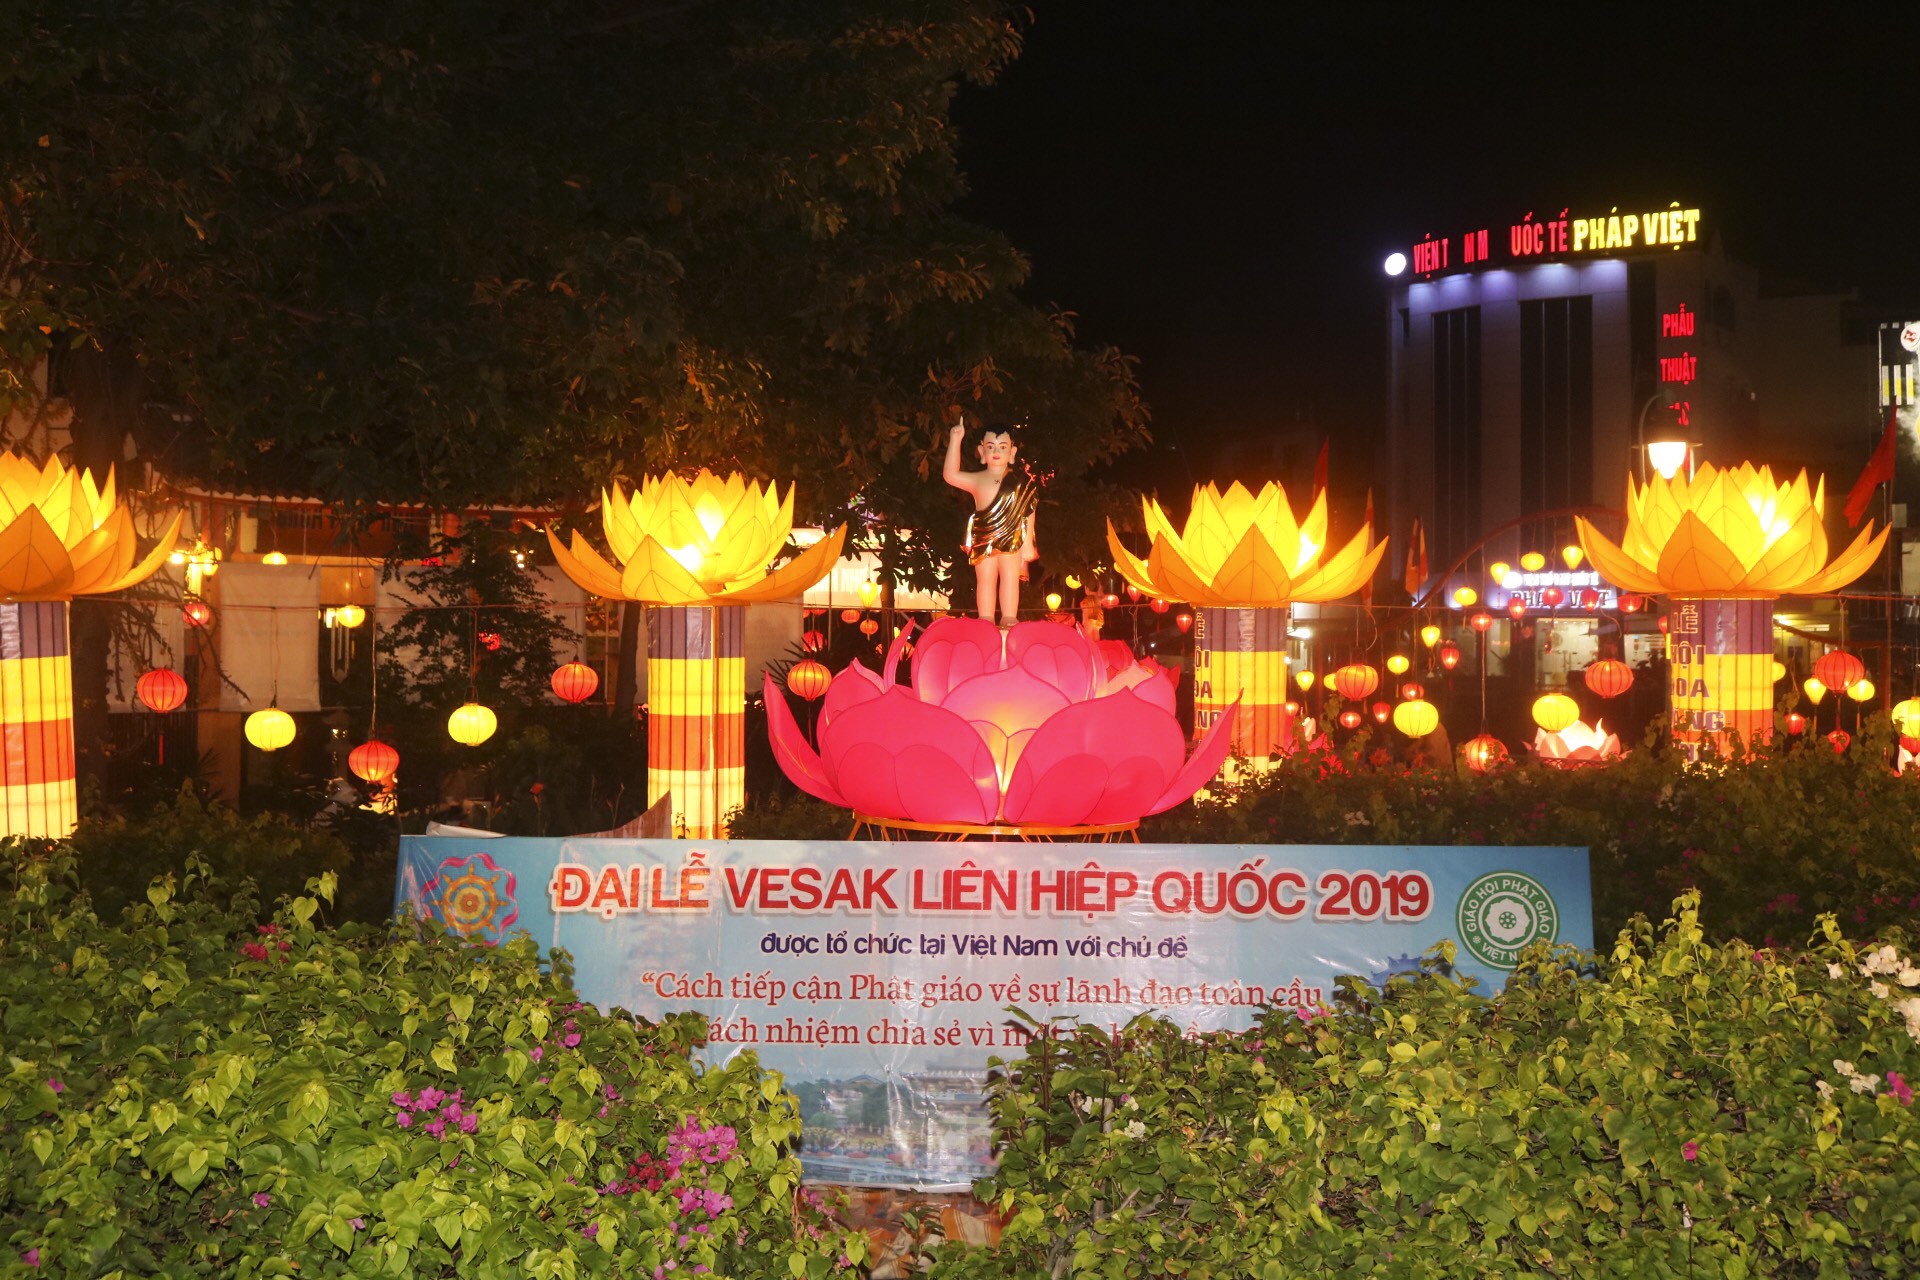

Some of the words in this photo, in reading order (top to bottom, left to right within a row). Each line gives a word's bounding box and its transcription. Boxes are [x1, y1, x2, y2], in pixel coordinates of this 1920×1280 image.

[1548, 207, 1568, 253] TẾ
[1573, 206, 1640, 252] PHÁP
[1642, 201, 1701, 250] VIỆT
[1662, 303, 1696, 338] PHẪU
[1660, 352, 1697, 385] THUẬT
[553, 867, 640, 915] ĐẠI
[652, 851, 711, 909] LỄ
[724, 867, 898, 910] VESAK
[913, 860, 1018, 911] LIÊN
[1031, 861, 1139, 919] HIỆP
[1152, 858, 1306, 916] QUỐC
[1319, 873, 1430, 917] 2019
[1464, 899, 1480, 932] GIÁO
[1535, 900, 1553, 934] GIÁO
[760, 932, 820, 957] được
[826, 930, 849, 954] tổ
[854, 932, 913, 955] chức
[920, 933, 946, 959] tại
[952, 934, 997, 959] Việt
[1003, 934, 1058, 957] Nam
[1066, 935, 1101, 958] với
[1106, 935, 1151, 958] chủ
[1157, 935, 1188, 958] đề
[731, 970, 786, 1006] tiếp
[792, 976, 843, 1004] cận
[849, 974, 916, 1005] Phật
[921, 974, 983, 1008] giáo
[988, 973, 1022, 1003] về
[1028, 981, 1061, 1007] sự
[1067, 976, 1131, 1004] lãnh
[1139, 978, 1193, 1009] đạo
[1200, 979, 1264, 1007] toàn
[1272, 977, 1323, 1008] cầu
[765, 1017, 860, 1048] nhiệm
[866, 1018, 928, 1046] chia
[934, 1020, 962, 1046] sẻ
[968, 1021, 997, 1046] vì
